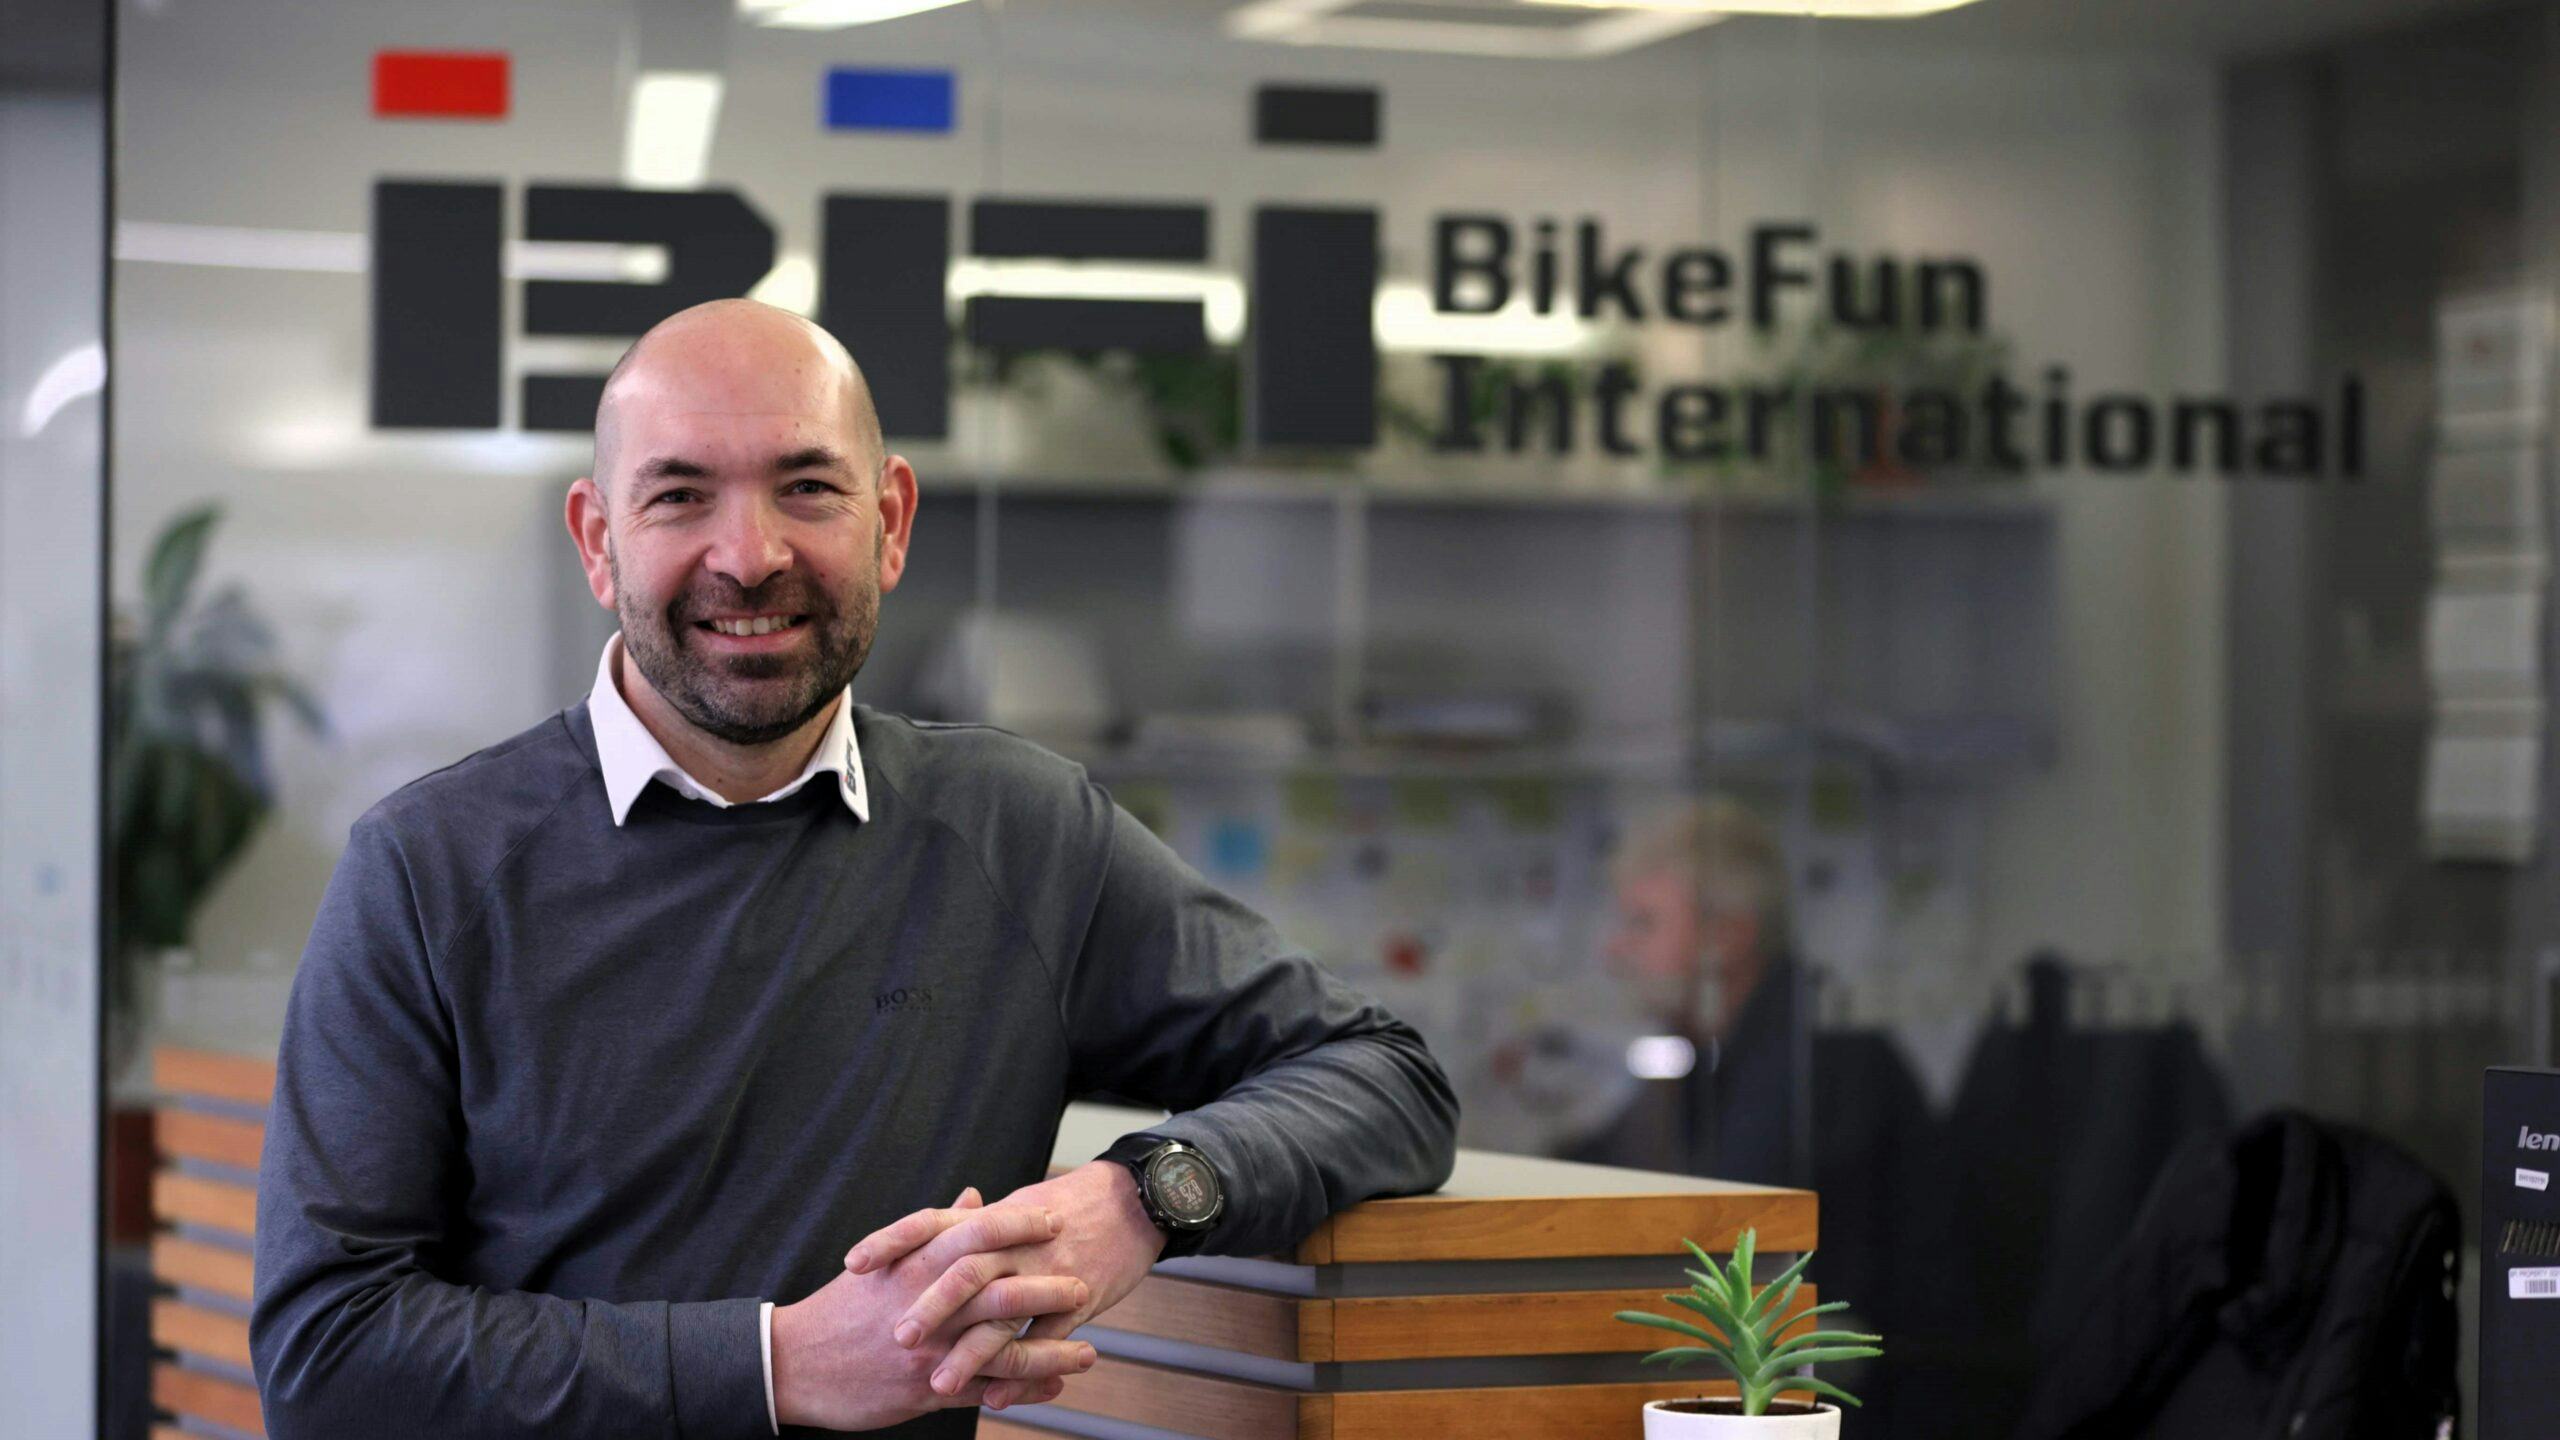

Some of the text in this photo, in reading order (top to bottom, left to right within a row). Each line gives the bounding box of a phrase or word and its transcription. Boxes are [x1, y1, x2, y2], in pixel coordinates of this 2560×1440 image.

[1432, 214, 1984, 333] BikeFun
[1434, 356, 2365, 477] International
[875, 989, 933, 1008] BOSS
[2518, 1126, 2560, 1151] len
